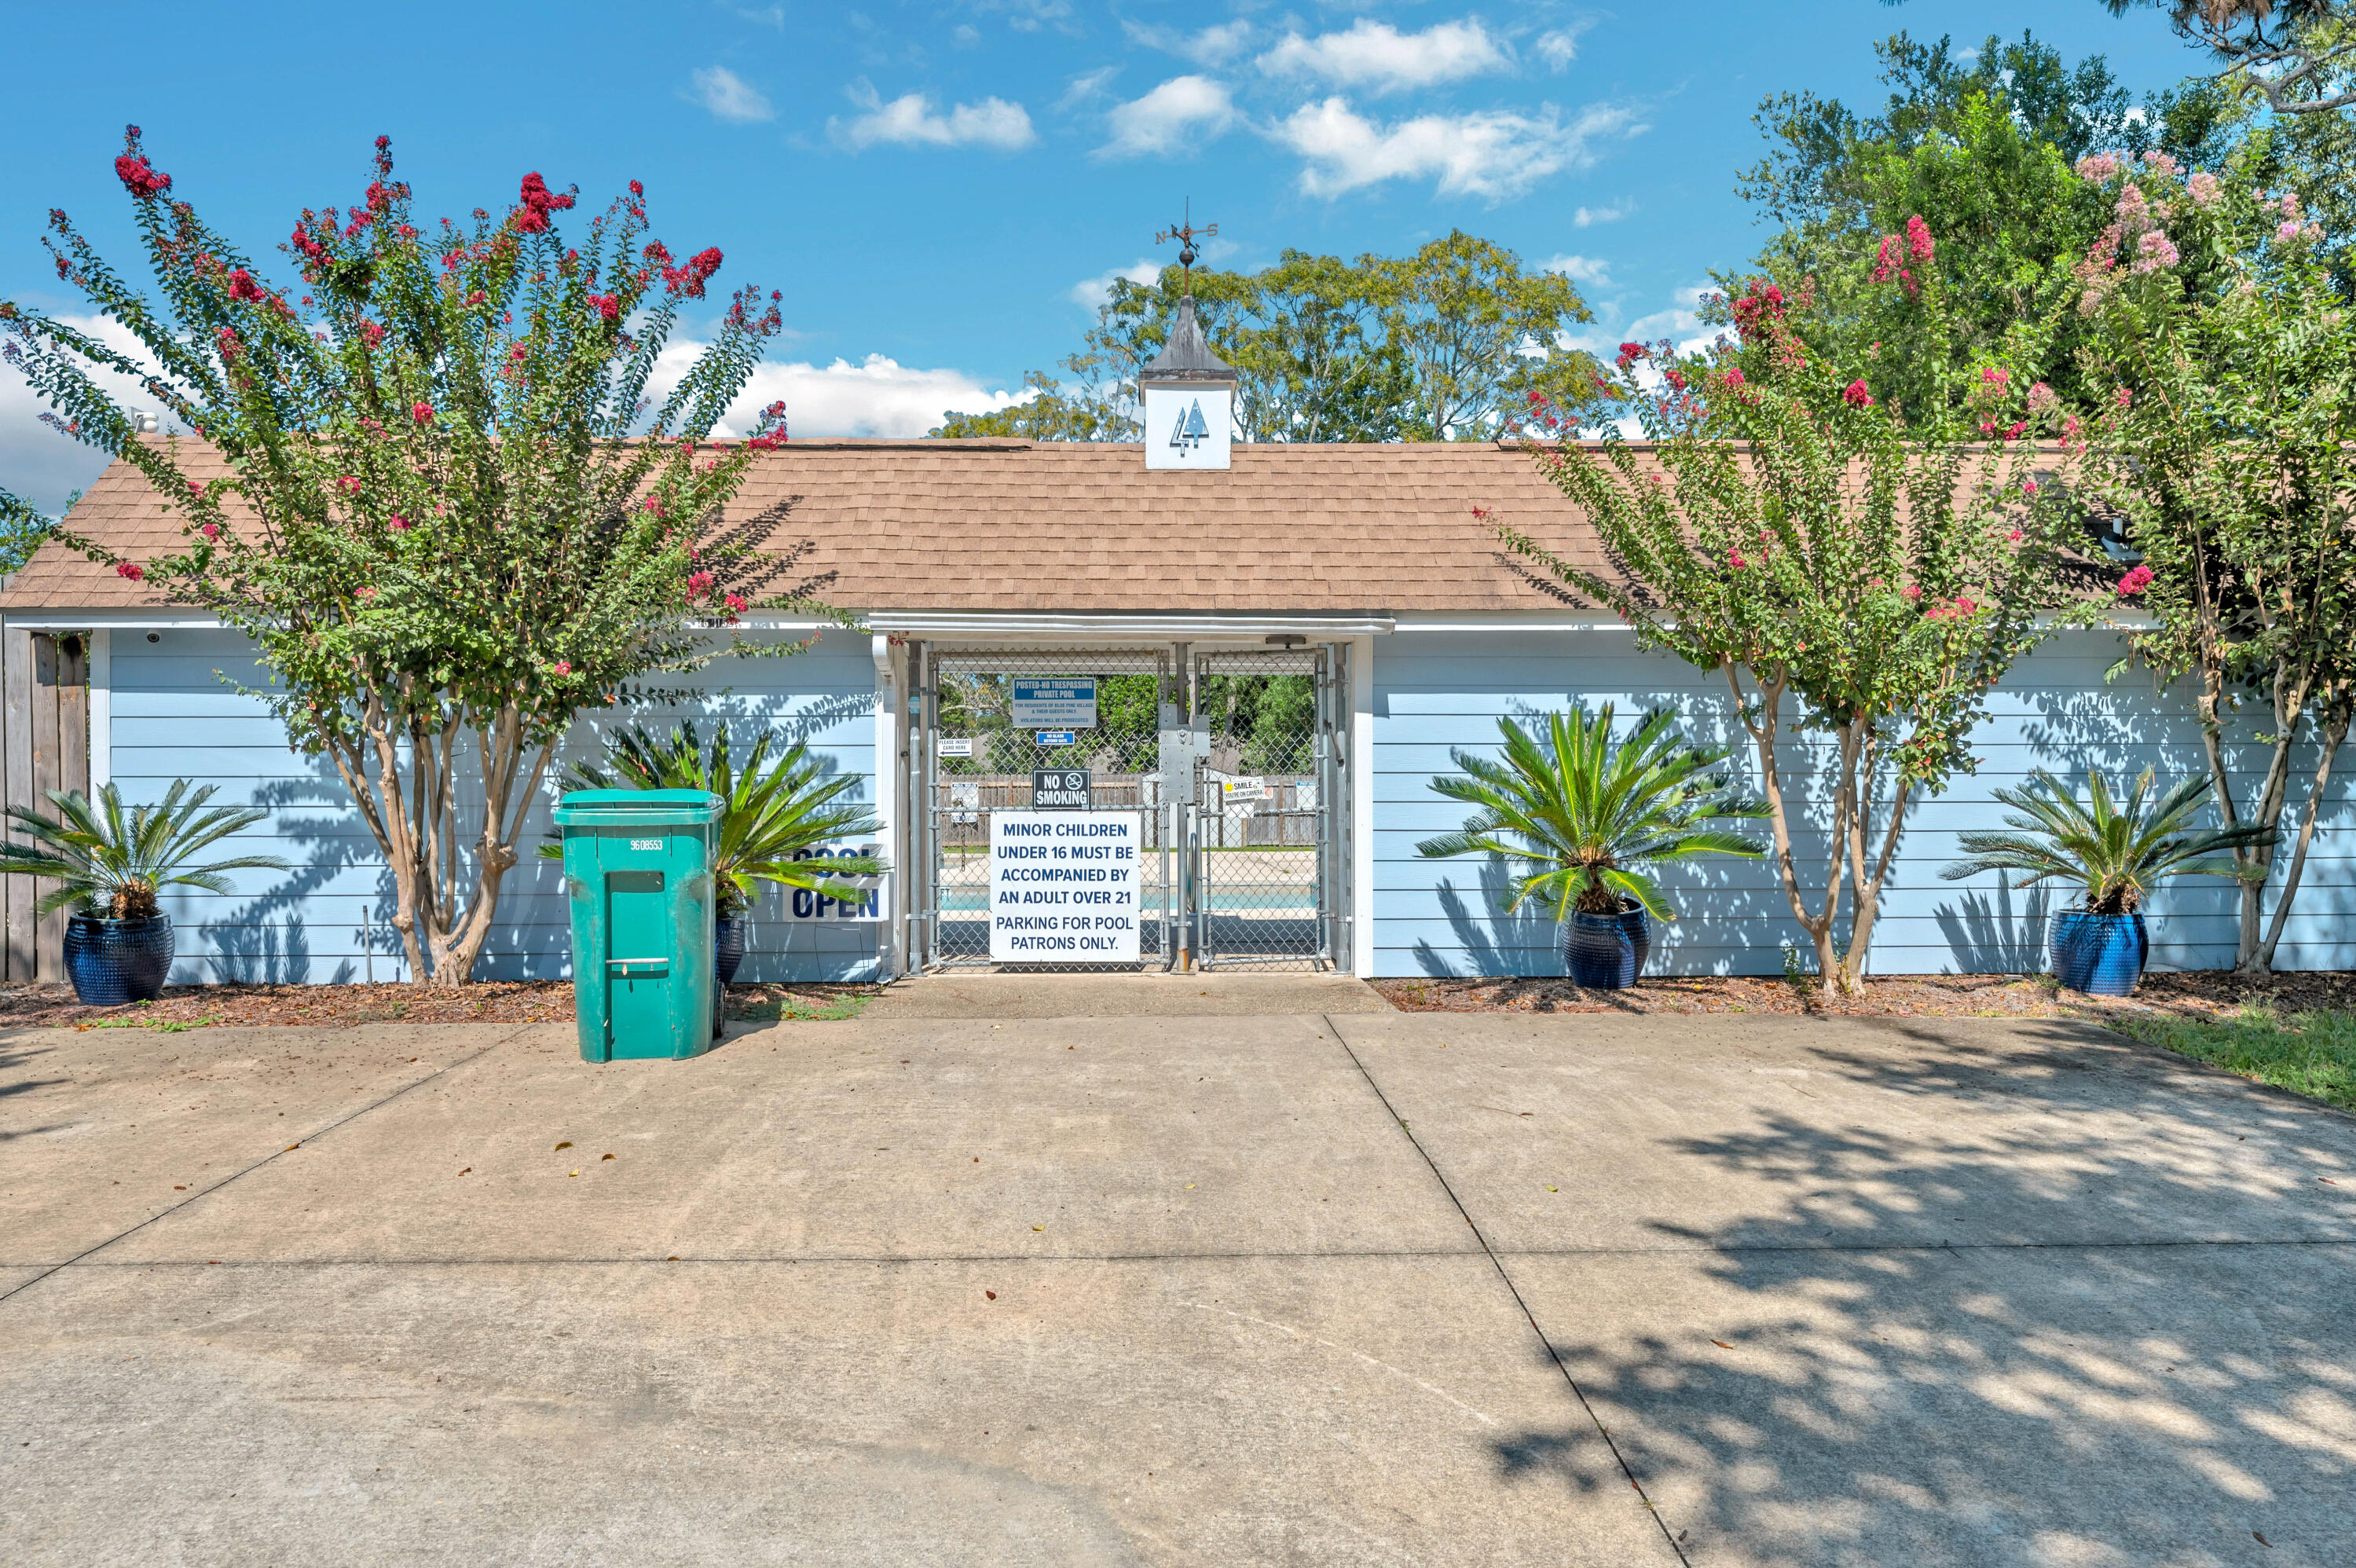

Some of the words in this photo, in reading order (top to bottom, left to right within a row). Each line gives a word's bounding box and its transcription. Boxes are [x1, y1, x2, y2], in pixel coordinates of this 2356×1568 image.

[1044, 775, 1060, 789] NO
[1036, 790, 1087, 804] SMOKING
[1003, 824, 1051, 836] MINOR
[1056, 824, 1127, 836] CHILDREN
[631, 840, 662, 850] 9608553
[998, 846, 1046, 859] UNDER
[1051, 846, 1067, 859] 16
[1072, 846, 1111, 859] MUST
[1116, 846, 1133, 859] BE
[1001, 869, 1106, 881] ACCOMPANIED
[1111, 869, 1129, 881] BY
[793, 888, 878, 918] OPEN
[998, 891, 1019, 903] AN
[1023, 891, 1068, 903] ADULT
[1073, 891, 1111, 903] OVER
[1116, 891, 1130, 903] 21
[996, 917, 1057, 929] PARKING
[1062, 917, 1090, 929] FOR
[1095, 917, 1133, 929] POOL
[1011, 937, 1075, 949] PATRONS
[1080, 937, 1118, 949] ONLY.
